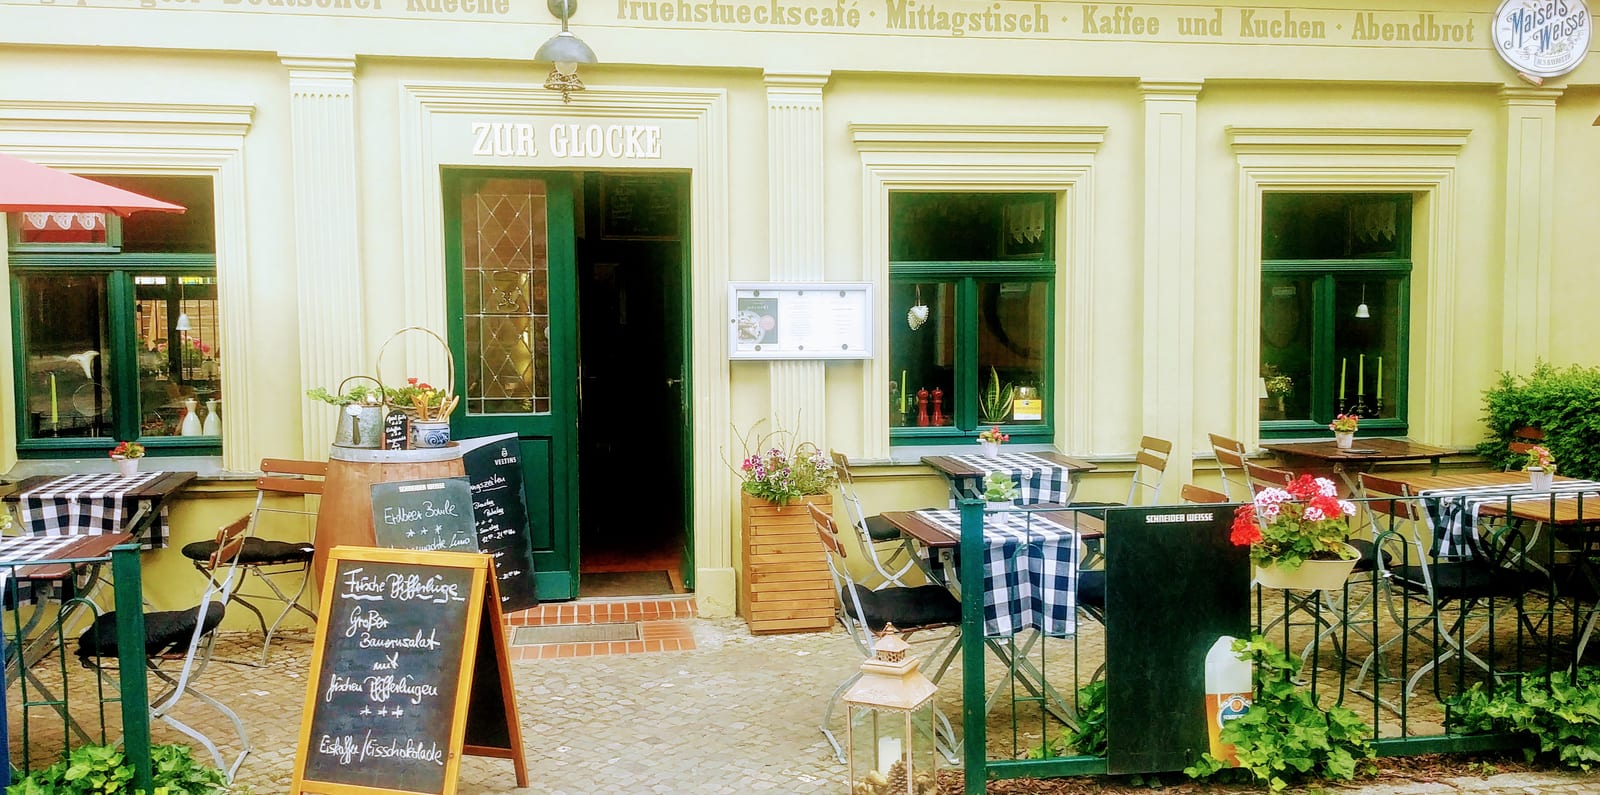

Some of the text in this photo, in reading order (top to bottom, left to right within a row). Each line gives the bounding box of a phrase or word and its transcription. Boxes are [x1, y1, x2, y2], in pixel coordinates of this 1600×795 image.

[886, 1, 1048, 36] Mittagstisch
[1082, 6, 1159, 35] Kaffee
[1178, 9, 1223, 36] und
[1240, 9, 1326, 39] Kuchen
[1352, 13, 1475, 42] Abendbrot
[1533, 10, 1585, 52] Weisse
[472, 122, 662, 159] ZUR GLOCKE
[494, 457, 517, 466] VELTINS
[384, 507, 423, 525] Erdbeer
[1145, 512, 1214, 524] SCHNEIDER WEISSE
[360, 629, 440, 650] Bauernsalat
